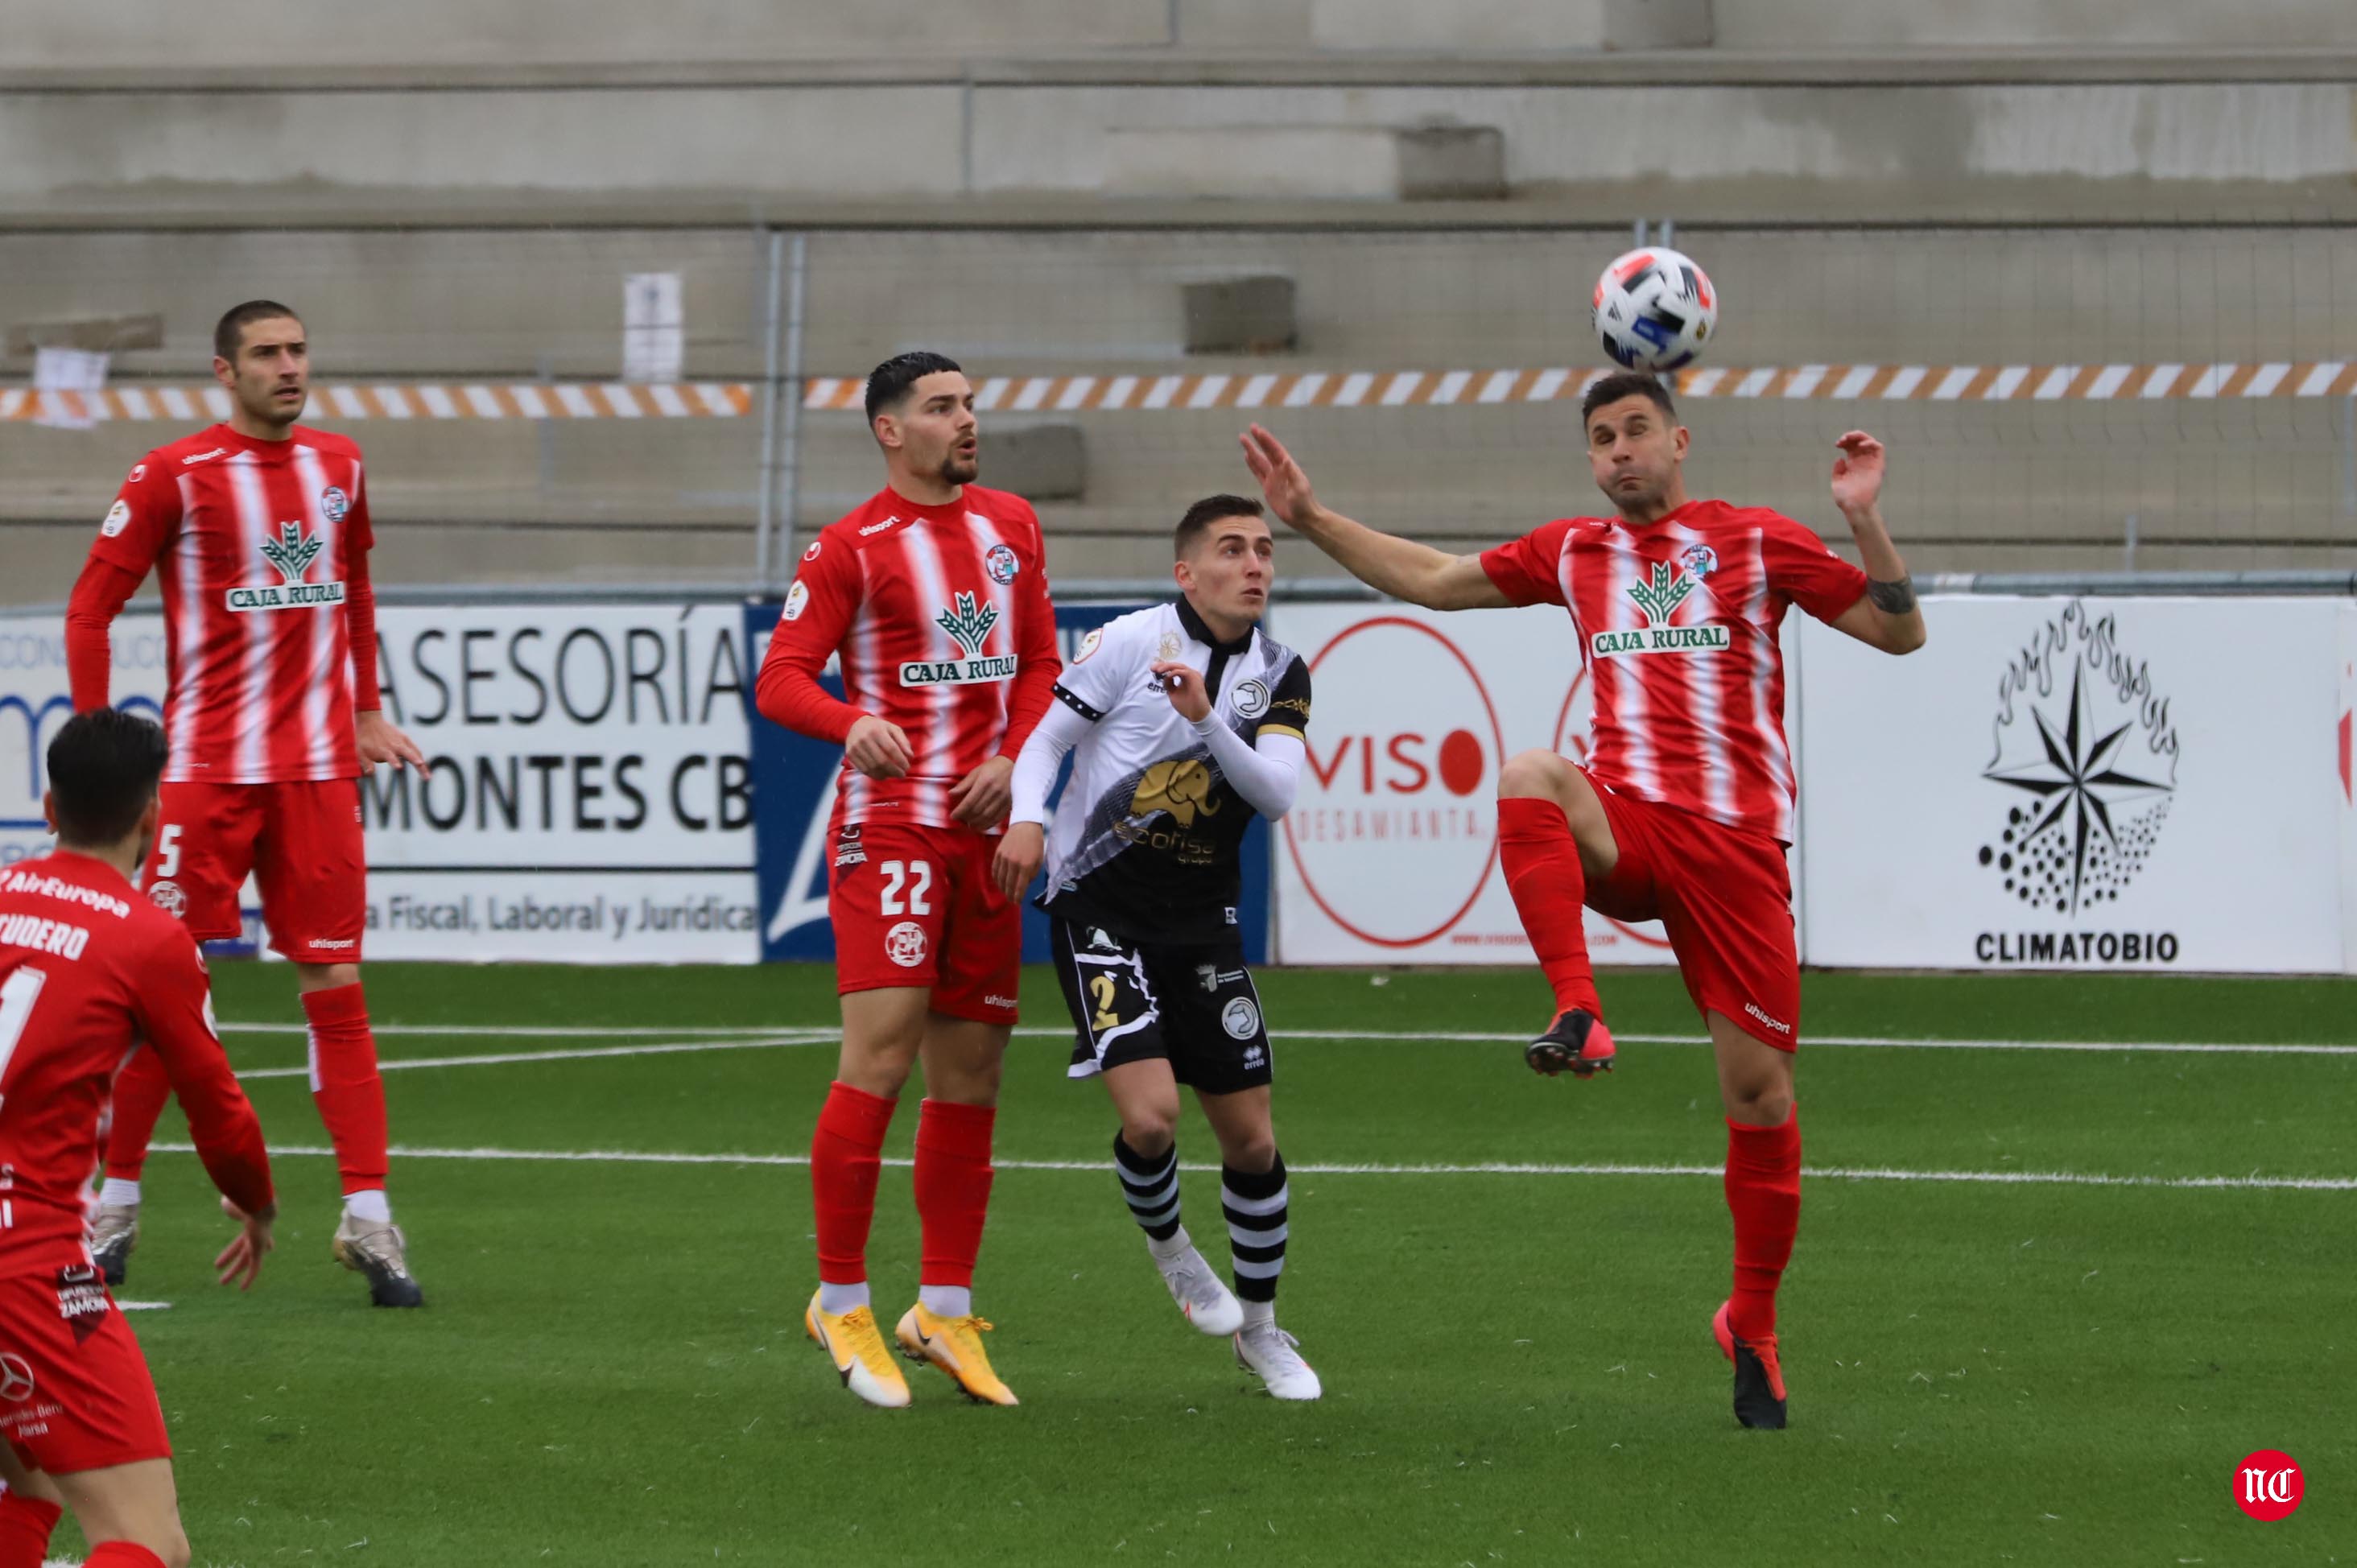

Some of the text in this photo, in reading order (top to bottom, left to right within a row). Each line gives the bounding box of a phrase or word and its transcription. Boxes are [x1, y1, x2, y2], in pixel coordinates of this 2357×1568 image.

[182, 448, 227, 464] uhlsport
[859, 515, 900, 537] uhlsport
[229, 584, 342, 609] CAJA RURAL
[1595, 626, 1728, 653] CAJA RURAL
[376, 605, 743, 725] ASESORÍA
[903, 656, 1016, 683] CAJA RURAL
[359, 753, 753, 831] MONTES CB
[157, 824, 182, 877] 5
[881, 860, 931, 916] 22
[388, 893, 478, 935] Fiscal,
[487, 893, 603, 930] Laboral
[613, 903, 628, 941] y
[638, 893, 757, 932] Jurídica
[308, 938, 354, 951] uhlsport
[1975, 933, 2178, 963] CLIMATOBIO
[1090, 975, 1120, 1031] 2
[1744, 1002, 1791, 1034] uhlsport
